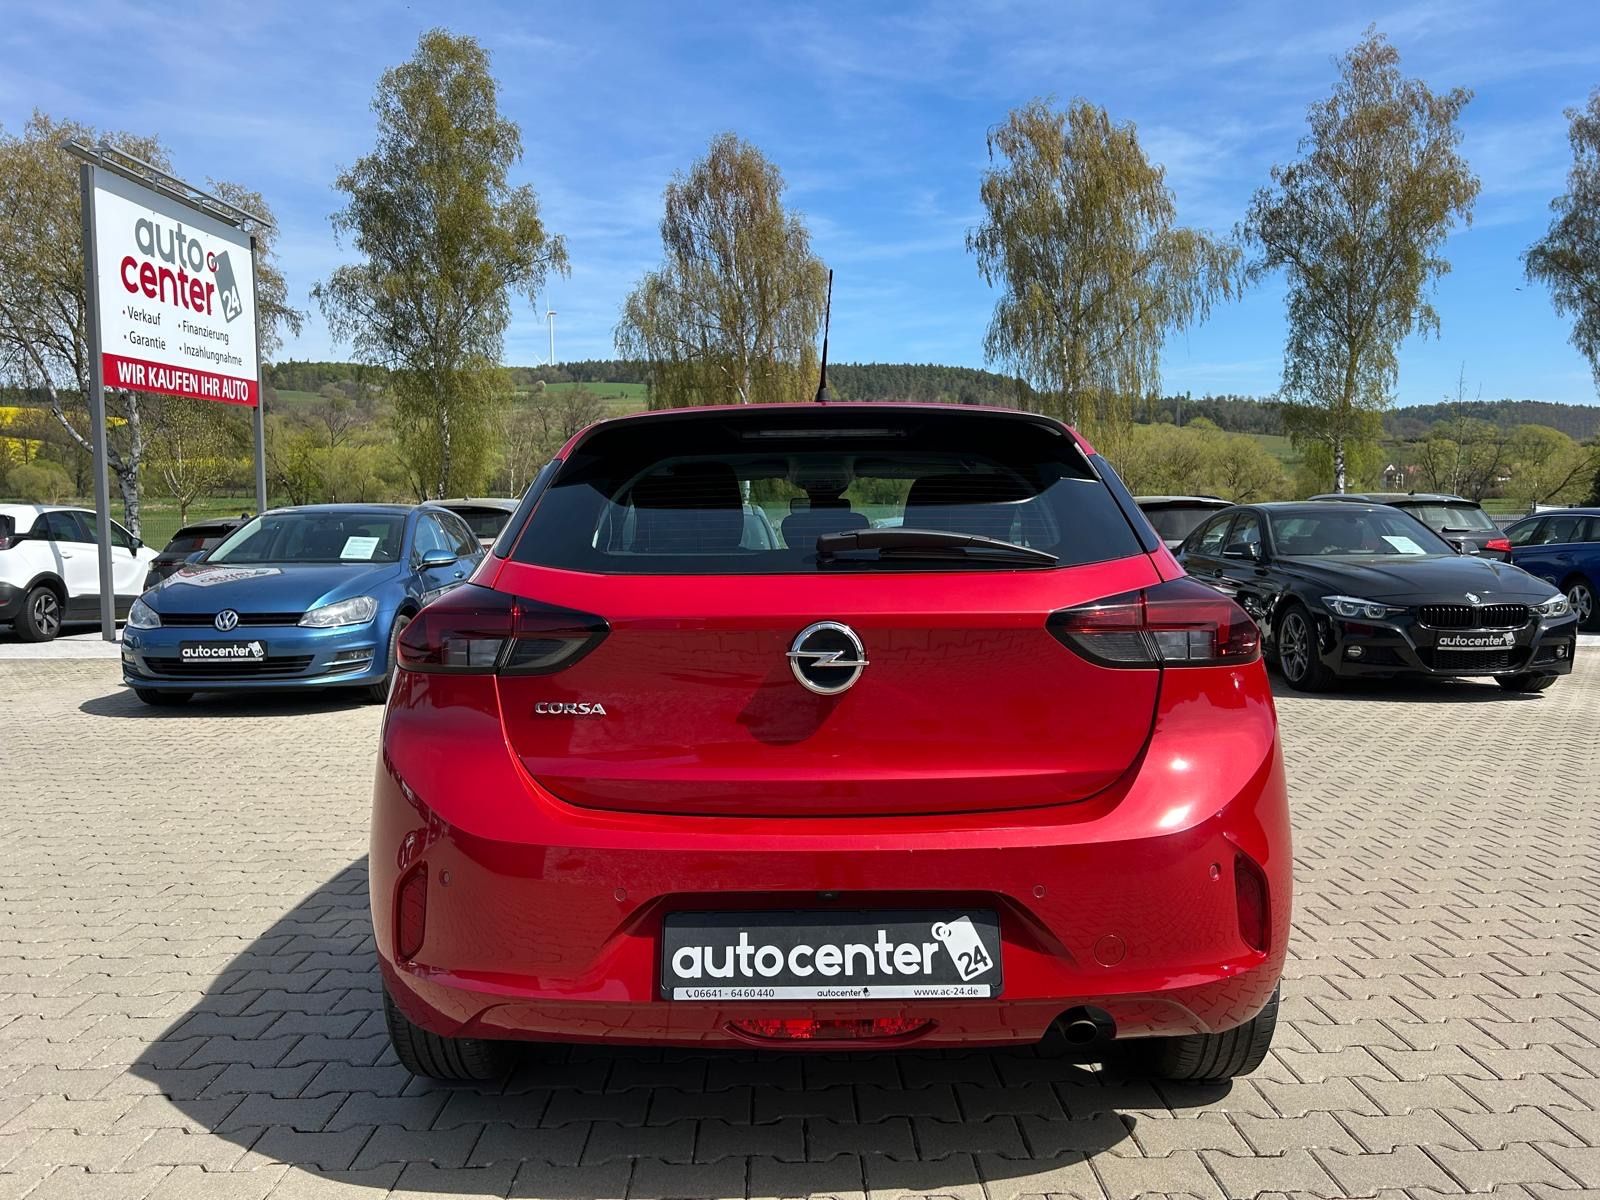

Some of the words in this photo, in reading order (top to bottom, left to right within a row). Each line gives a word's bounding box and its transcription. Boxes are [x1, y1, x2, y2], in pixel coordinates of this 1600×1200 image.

[135, 218, 204, 273] auto
[120, 256, 215, 316] center
[223, 290, 240, 317] 24
[127, 305, 161, 326] Verkauf
[129, 331, 166, 350] Garantie
[182, 320, 229, 346] Finanzierung
[184, 342, 242, 366] Inzahlungnahme
[117, 361, 146, 386] WIR
[148, 366, 199, 394] KAUFEN
[201, 375, 221, 398] IHR
[221, 378, 249, 401] AUTO
[182, 644, 250, 657] autocenter
[534, 702, 607, 716] CORSA
[671, 930, 938, 979] autocenter
[957, 945, 989, 977] 24
[694, 989, 722, 998] 06641
[816, 988, 861, 997] autocenter
[913, 987, 979, 996] www.ac-24.de
